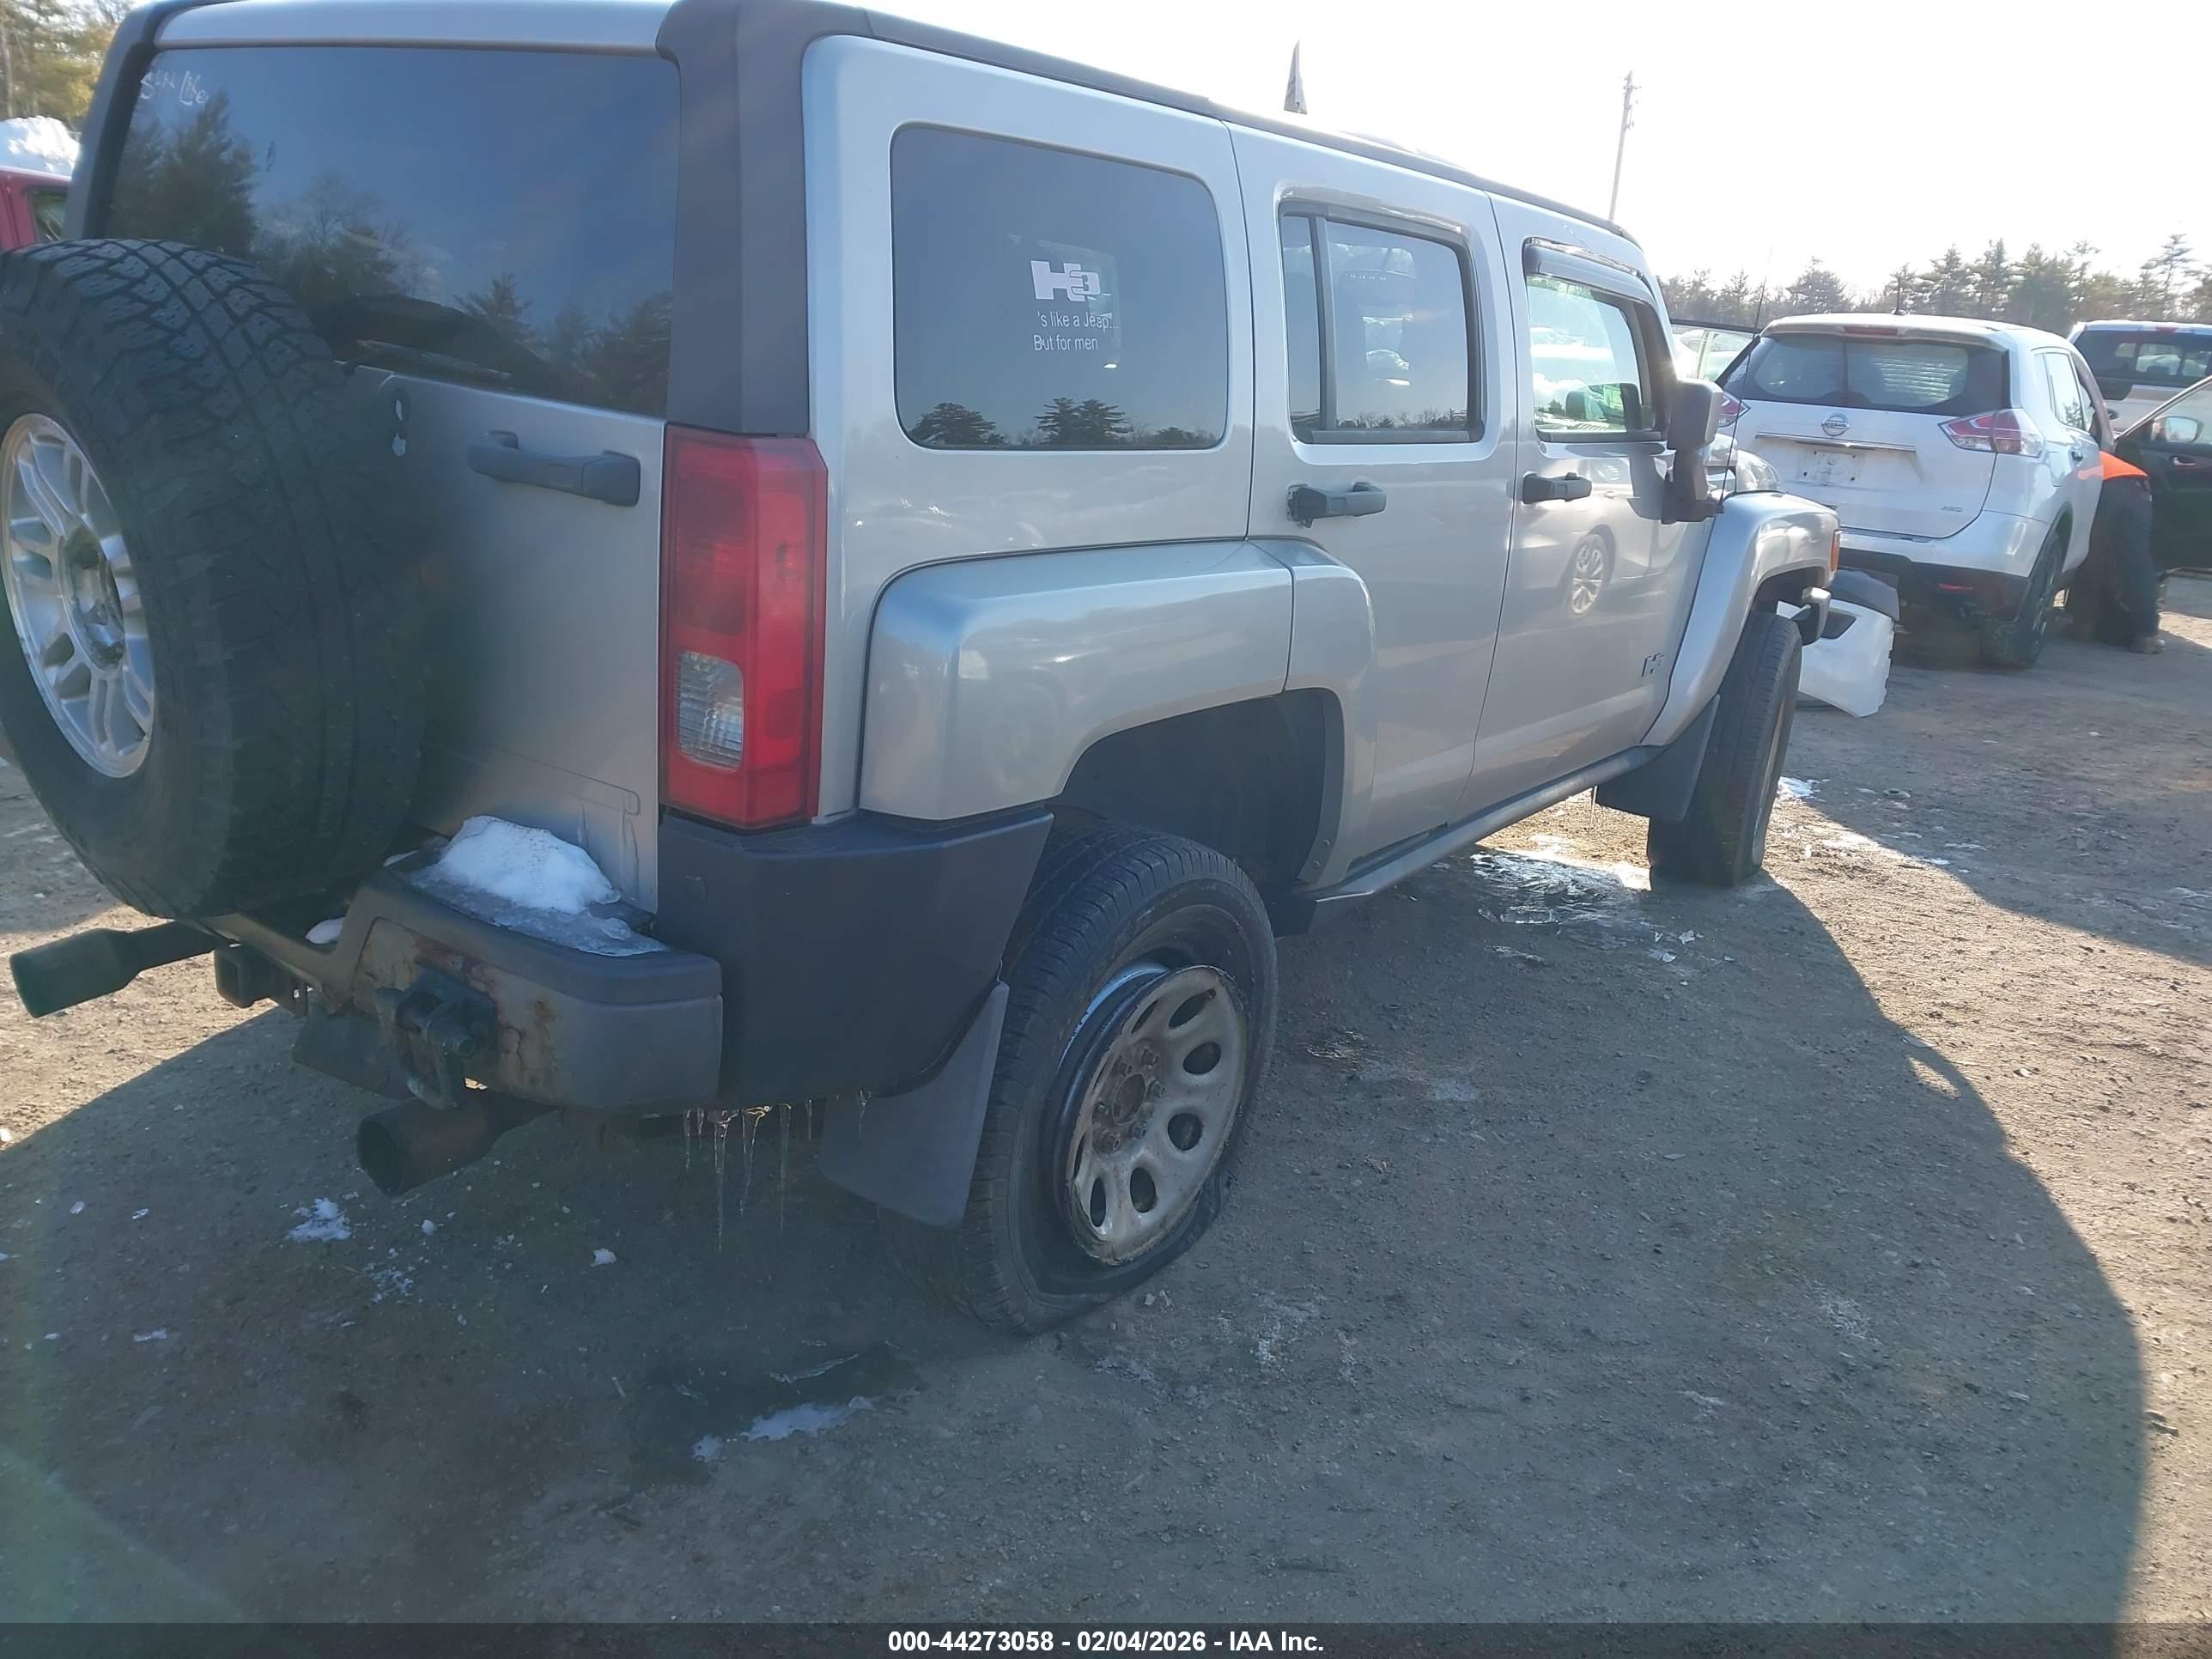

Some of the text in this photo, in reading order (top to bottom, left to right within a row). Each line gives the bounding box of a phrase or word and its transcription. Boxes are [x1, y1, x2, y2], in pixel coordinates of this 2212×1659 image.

[1030, 260, 1101, 302] H3
[1050, 311, 1070, 327] like
[1073, 315, 1080, 327] a
[1084, 312, 1119, 333] Jeep...
[1033, 334, 1098, 351] But for men
